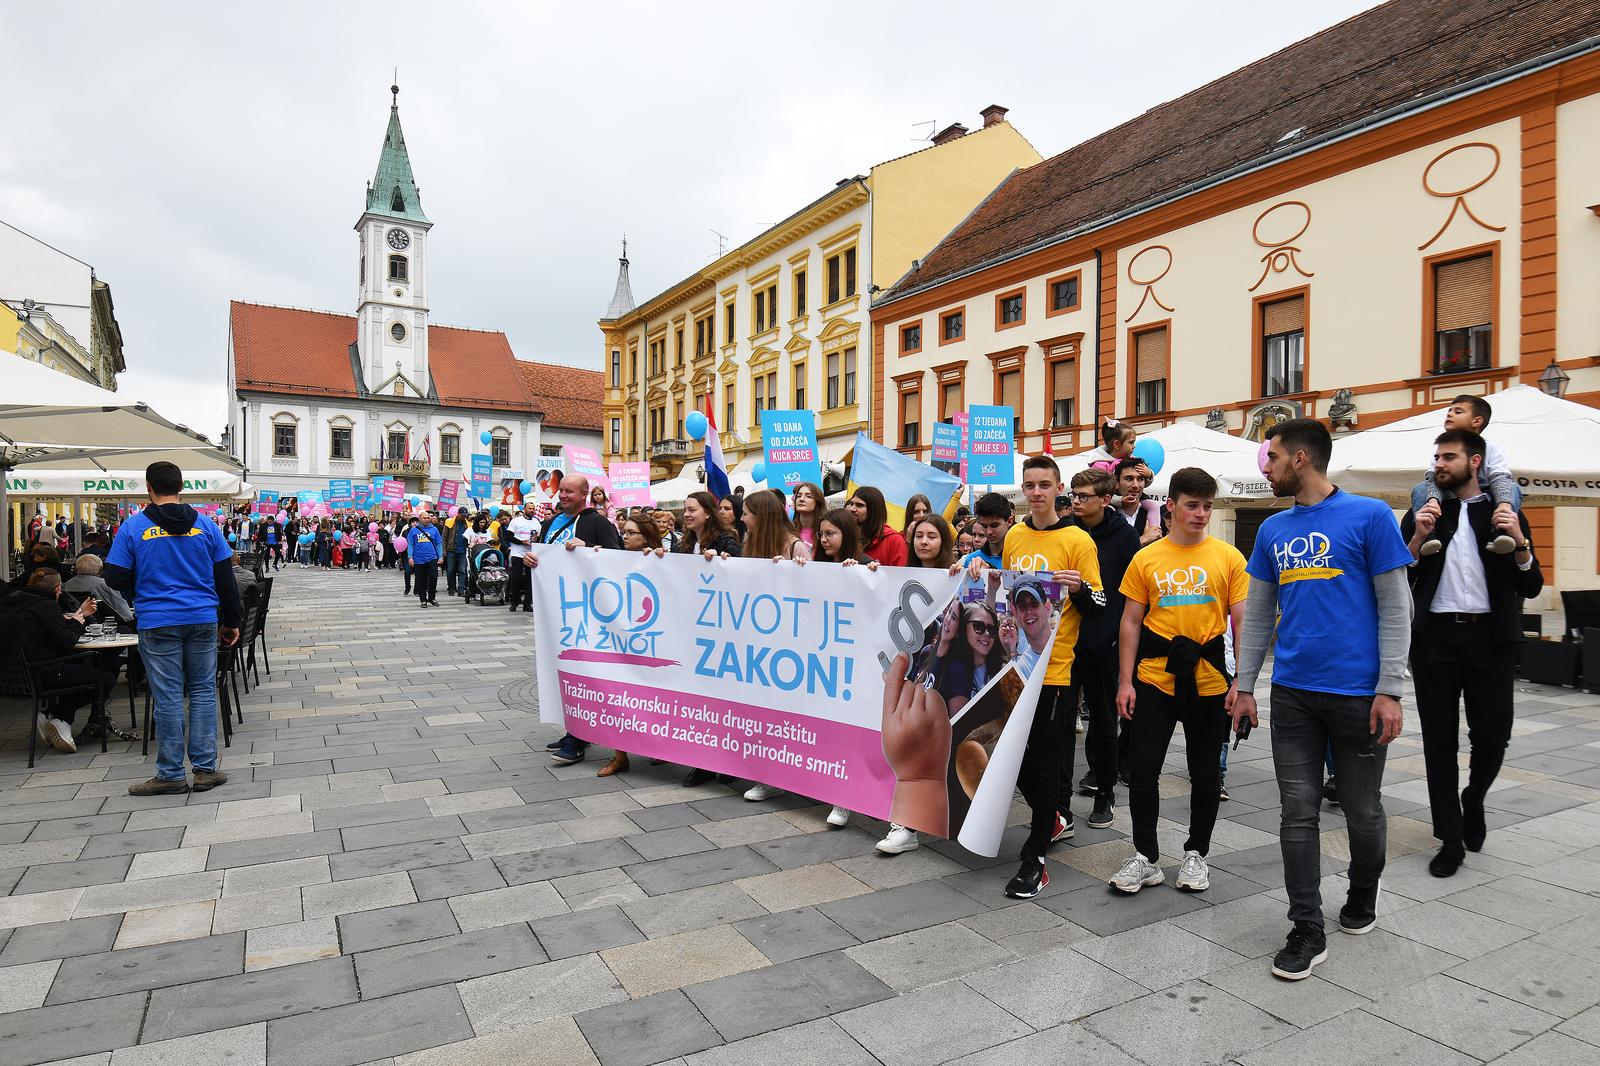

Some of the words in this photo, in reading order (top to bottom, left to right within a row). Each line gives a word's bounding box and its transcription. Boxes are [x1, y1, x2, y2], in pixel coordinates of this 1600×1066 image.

[773, 422, 782, 432] 18
[783, 422, 803, 432] DANA
[974, 416, 980, 426] 12
[982, 416, 1007, 426] TJEDANA
[974, 430, 982, 439] OD
[984, 429, 1006, 440] ZAČEĆA
[770, 437, 781, 447] OD
[782, 435, 809, 446] ZAČEĆA
[973, 444, 991, 453] SMIJE
[992, 444, 1000, 453] SE
[772, 451, 791, 461] KUCA
[792, 450, 810, 460] SRCE
[546, 458, 562, 468] ŽIVOT
[6, 479, 28, 490] AN
[84, 480, 124, 491] PAN
[182, 479, 207, 490] AN
[1533, 478, 1578, 488] COSTA
[1274, 532, 1330, 563] HOD
[1010, 553, 1048, 571] HOD
[1278, 558, 1290, 572] ZA
[1293, 555, 1334, 568] ŽIVOT
[1153, 565, 1208, 590] HOD
[1160, 586, 1173, 597] ZA
[1176, 585, 1210, 596] ŽIVOT
[560, 572, 660, 632] HOD
[696, 572, 810, 637] ŽIVOT
[818, 600, 854, 651] JE
[560, 621, 588, 647] ZA
[595, 625, 665, 658] ŽIVOT
[695, 638, 854, 701] ZAKON!
[563, 680, 605, 703] Tražimo
[608, 691, 670, 715] zakonsku
[673, 700, 678, 716] i
[681, 704, 719, 725] svaku
[723, 709, 762, 736] drugu
[766, 720, 816, 745] zaštitu
[565, 703, 598, 727] svakog
[600, 708, 647, 733] čovjeka
[651, 721, 670, 738] od
[672, 725, 718, 748] začeća
[722, 733, 739, 752] do
[743, 740, 802, 768] prirodne
[806, 757, 848, 780] smrti.
